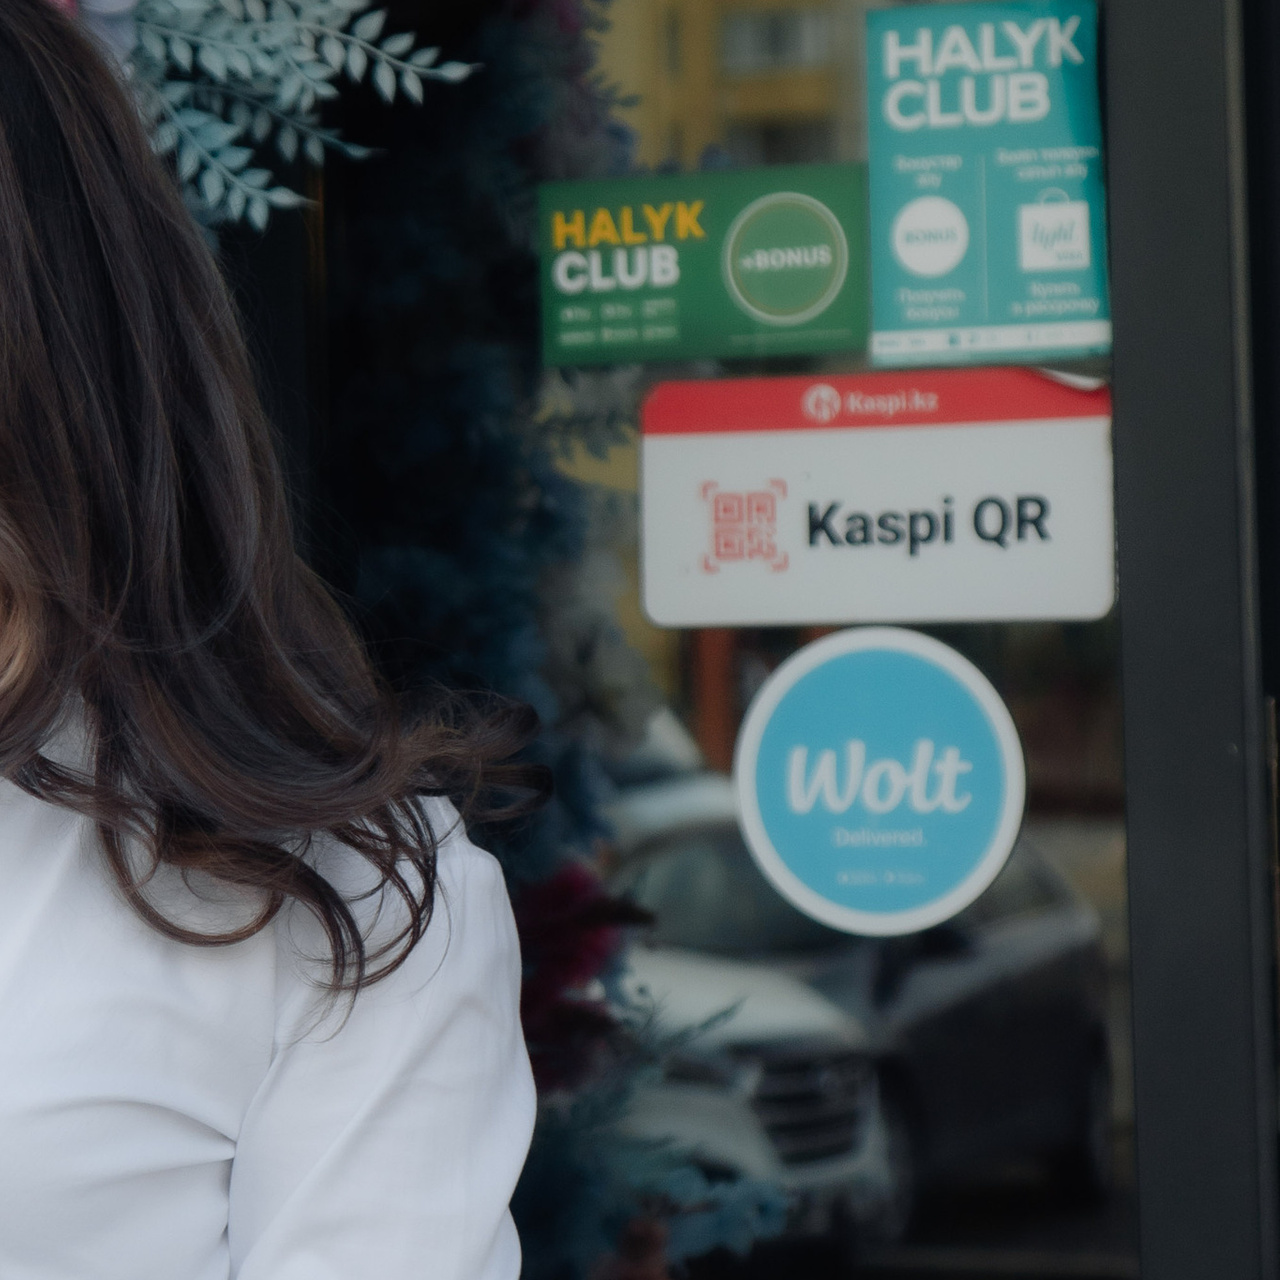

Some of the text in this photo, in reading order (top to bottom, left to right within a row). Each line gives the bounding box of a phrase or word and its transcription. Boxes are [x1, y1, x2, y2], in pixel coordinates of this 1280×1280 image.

[884, 16, 1085, 78] HALYK
[884, 72, 1051, 131] CLUB
[552, 200, 707, 249] HALYK
[552, 245, 680, 293] CLUB
[805, 495, 1052, 557] Kaspi QR
[784, 737, 973, 816] Wolt
